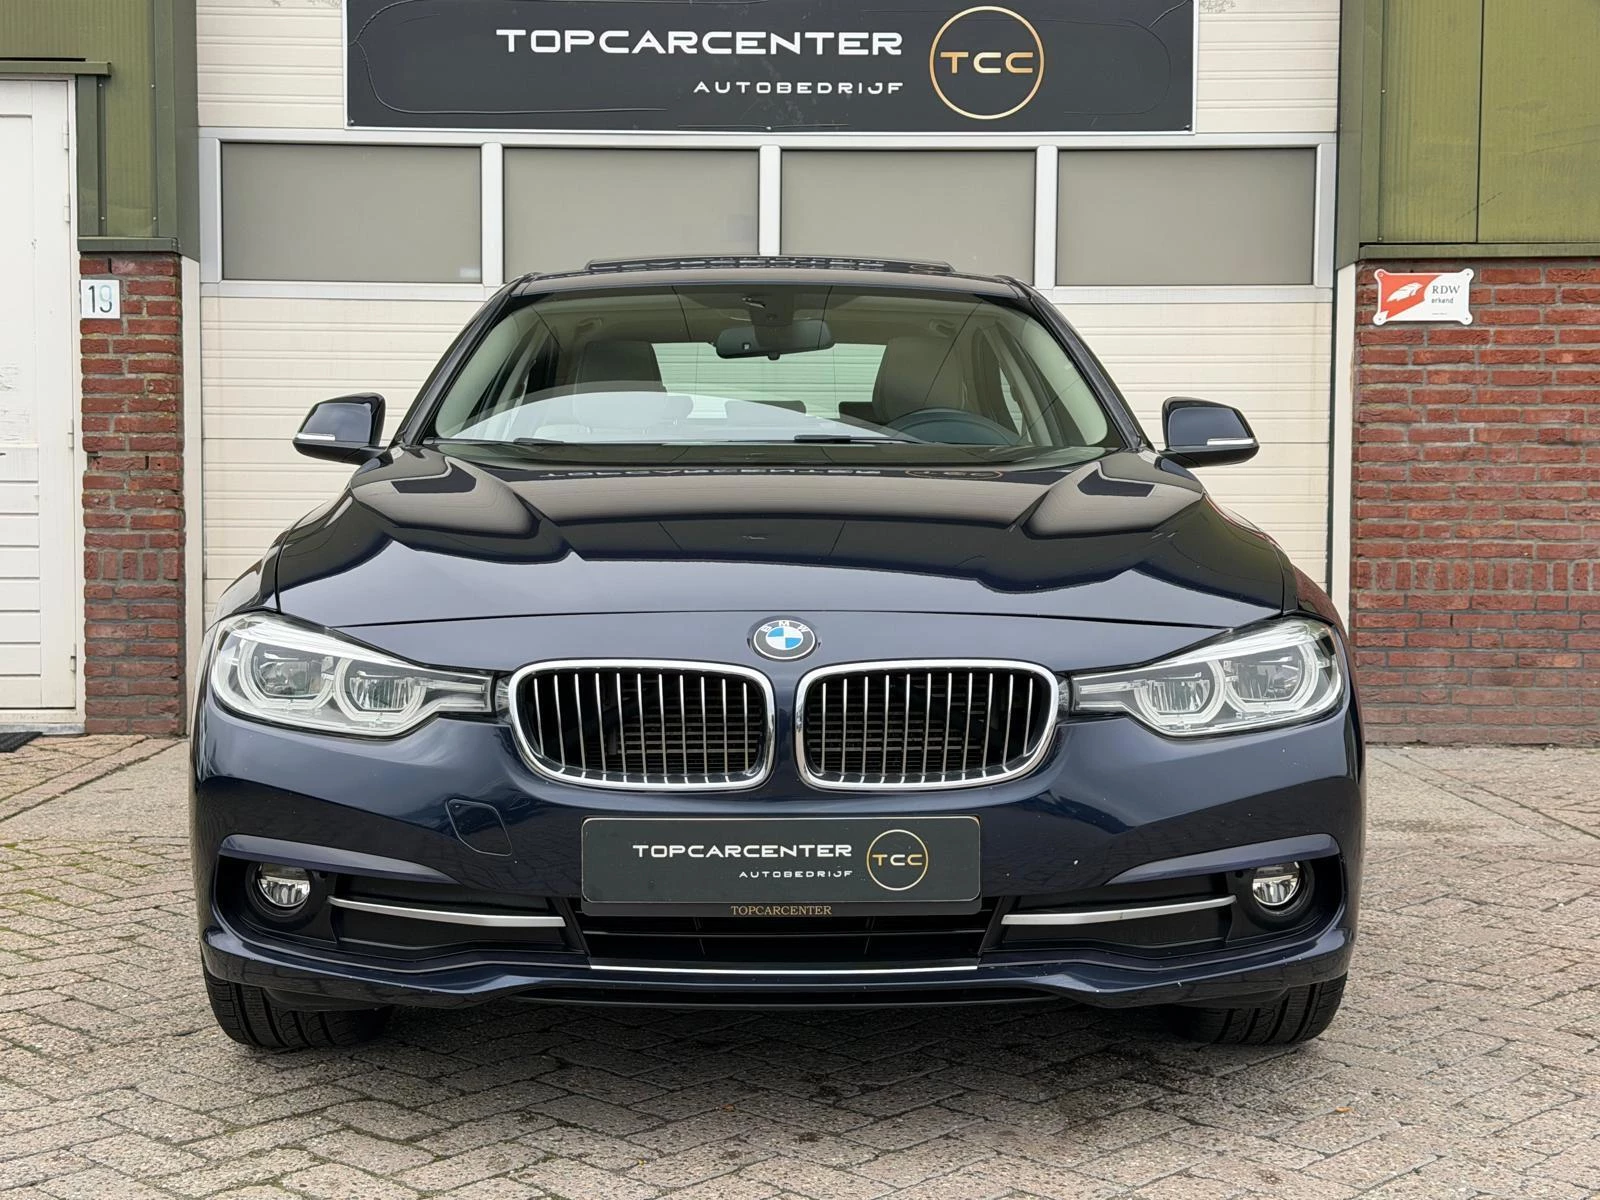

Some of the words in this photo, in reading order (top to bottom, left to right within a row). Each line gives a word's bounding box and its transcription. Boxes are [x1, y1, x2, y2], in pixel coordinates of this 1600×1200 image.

[495, 29, 903, 56] TOPCARCENTER
[940, 51, 1034, 74] TCC
[693, 81, 904, 95] AUTOBEDRIJF
[1431, 285, 1461, 295] RDW
[88, 284, 113, 313] 19
[632, 844, 852, 858] TOPCARCENTER
[872, 854, 923, 866] TCC
[738, 870, 853, 879] AUTOBEDRIJF
[730, 905, 832, 916] TOPCARCENTER
